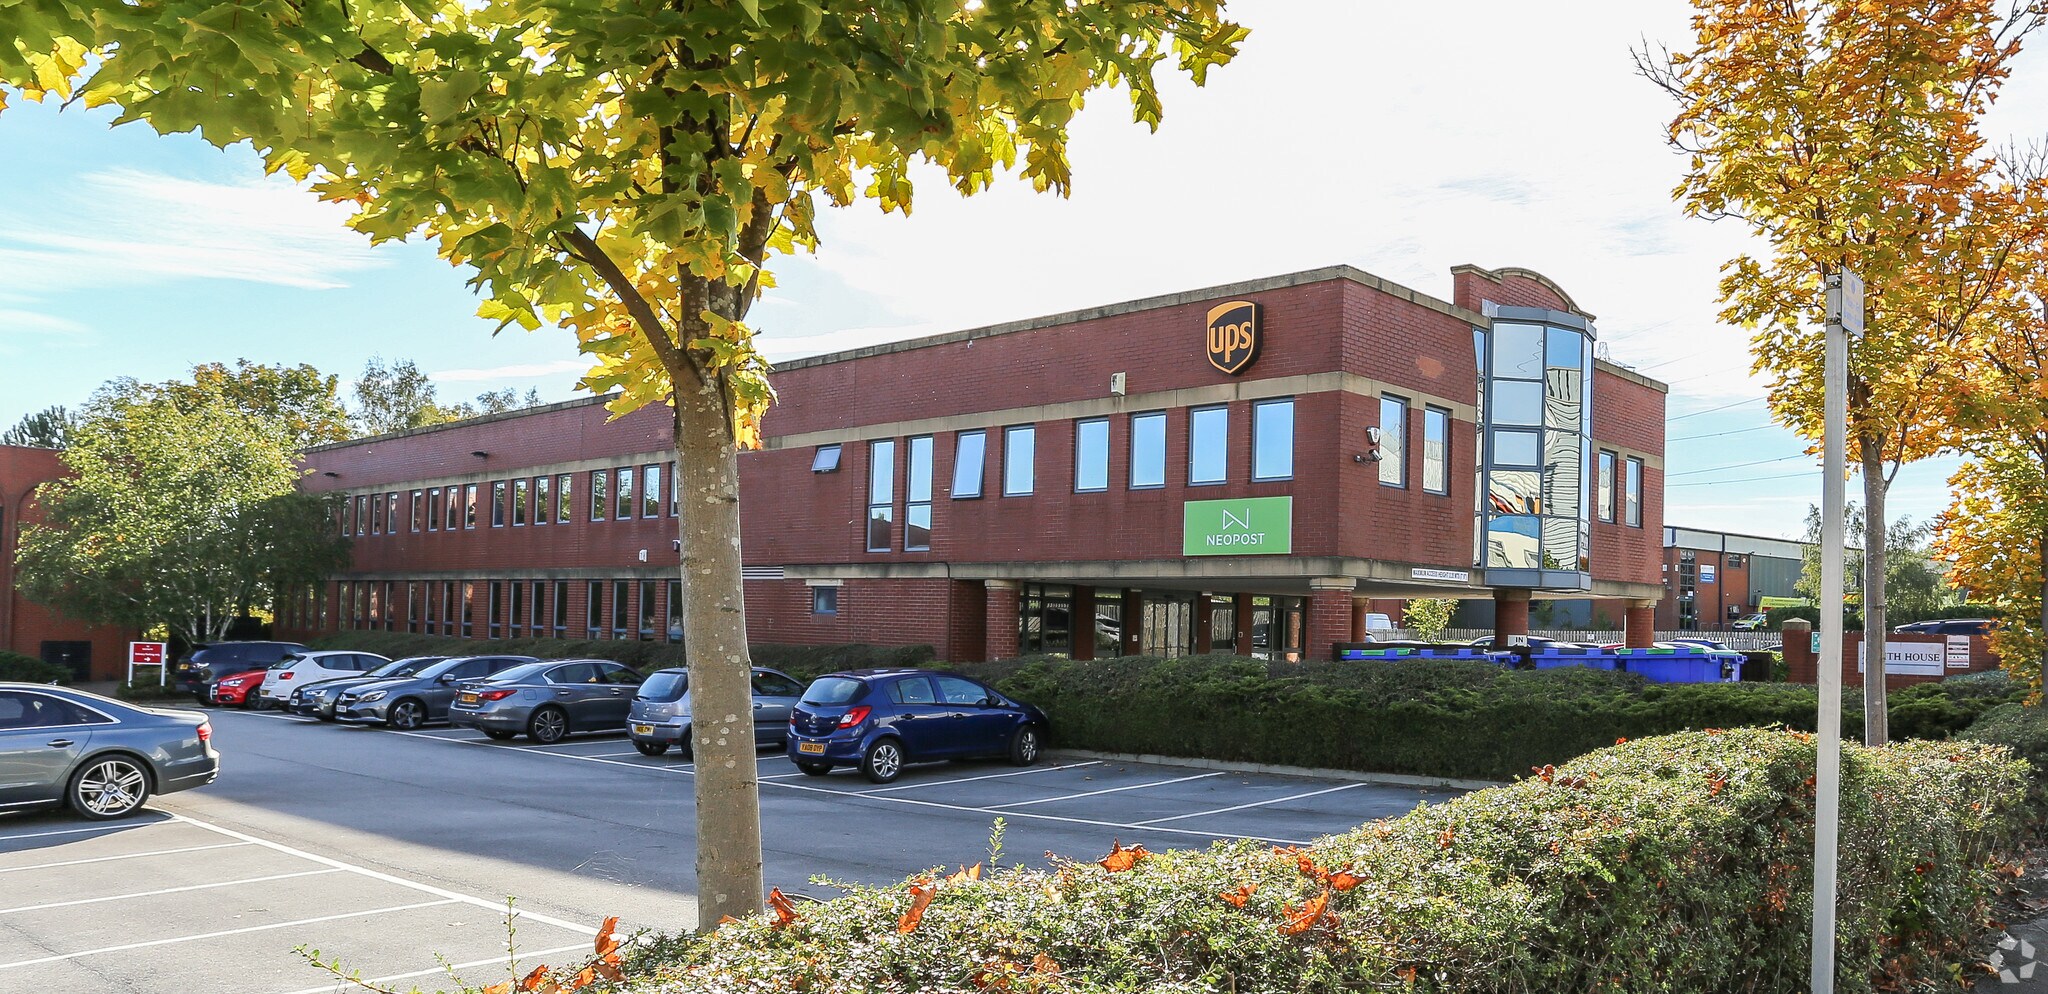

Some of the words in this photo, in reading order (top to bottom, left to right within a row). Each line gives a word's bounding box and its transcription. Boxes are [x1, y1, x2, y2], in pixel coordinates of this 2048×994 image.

[1210, 321, 1252, 363] ups
[1206, 533, 1265, 546] NEOPOST
[1905, 652, 1941, 662] HOUSE
